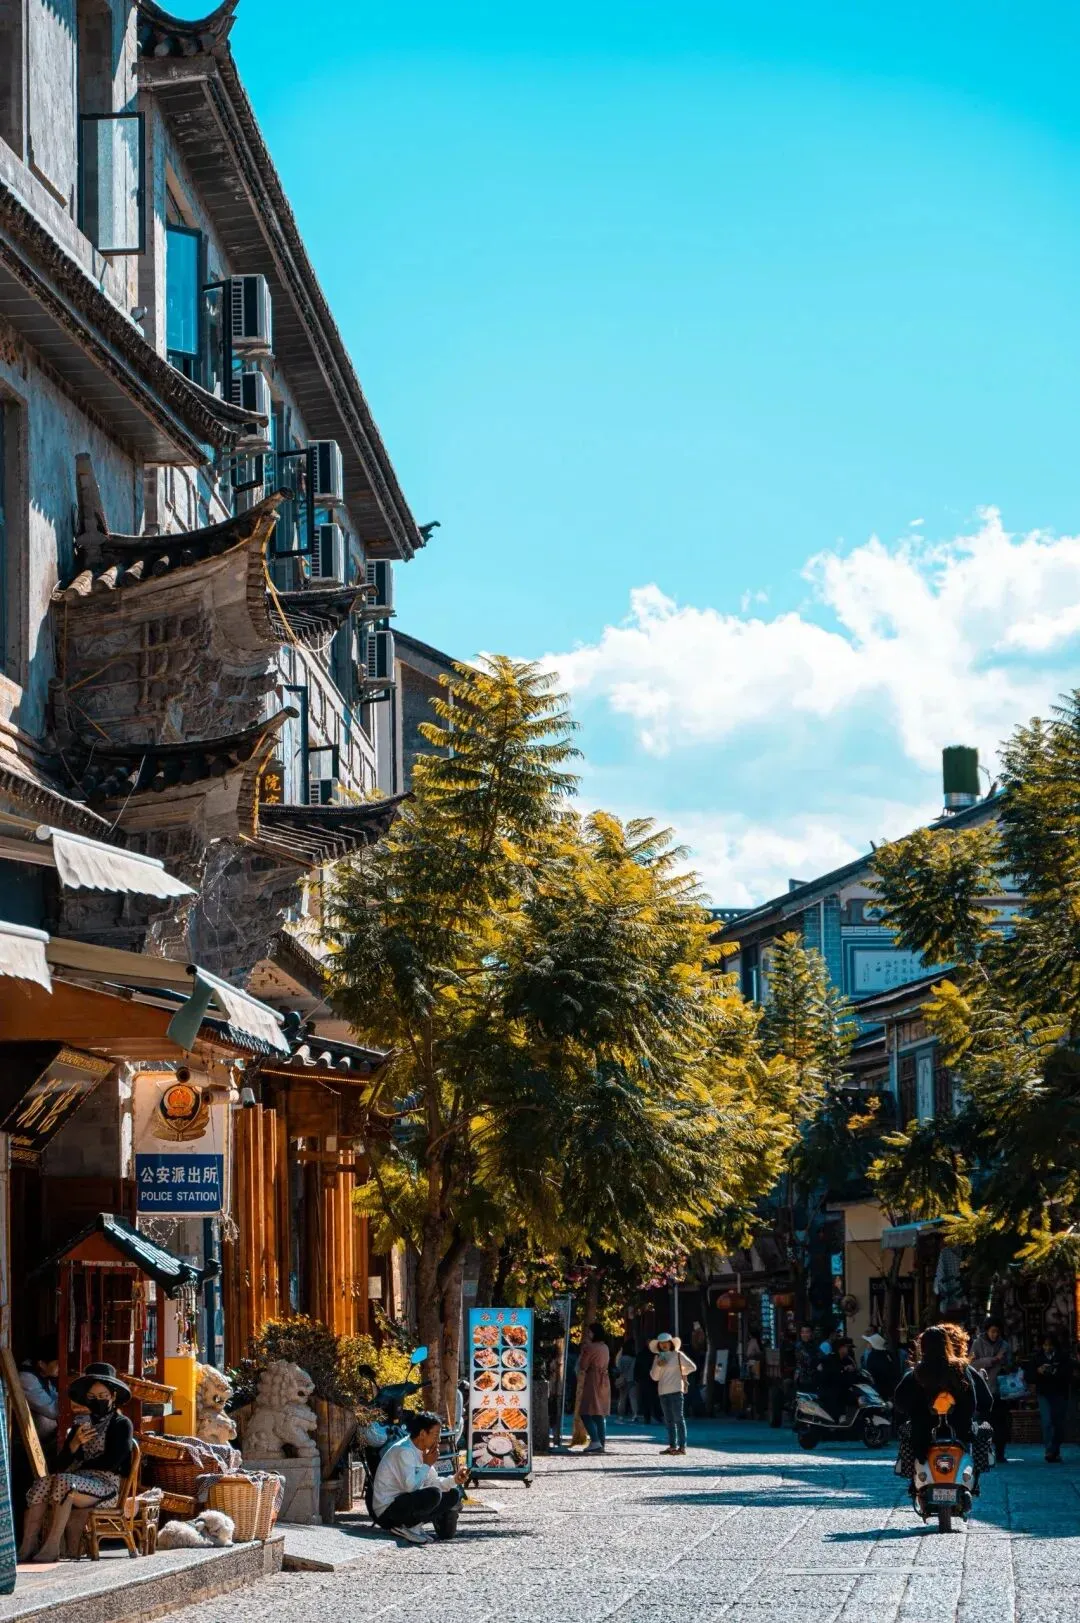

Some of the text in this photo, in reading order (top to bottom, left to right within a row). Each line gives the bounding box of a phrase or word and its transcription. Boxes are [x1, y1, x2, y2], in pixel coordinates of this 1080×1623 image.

[140, 1166, 218, 1184] 公安派出所
[141, 1191, 217, 1201] POLICE STATION
